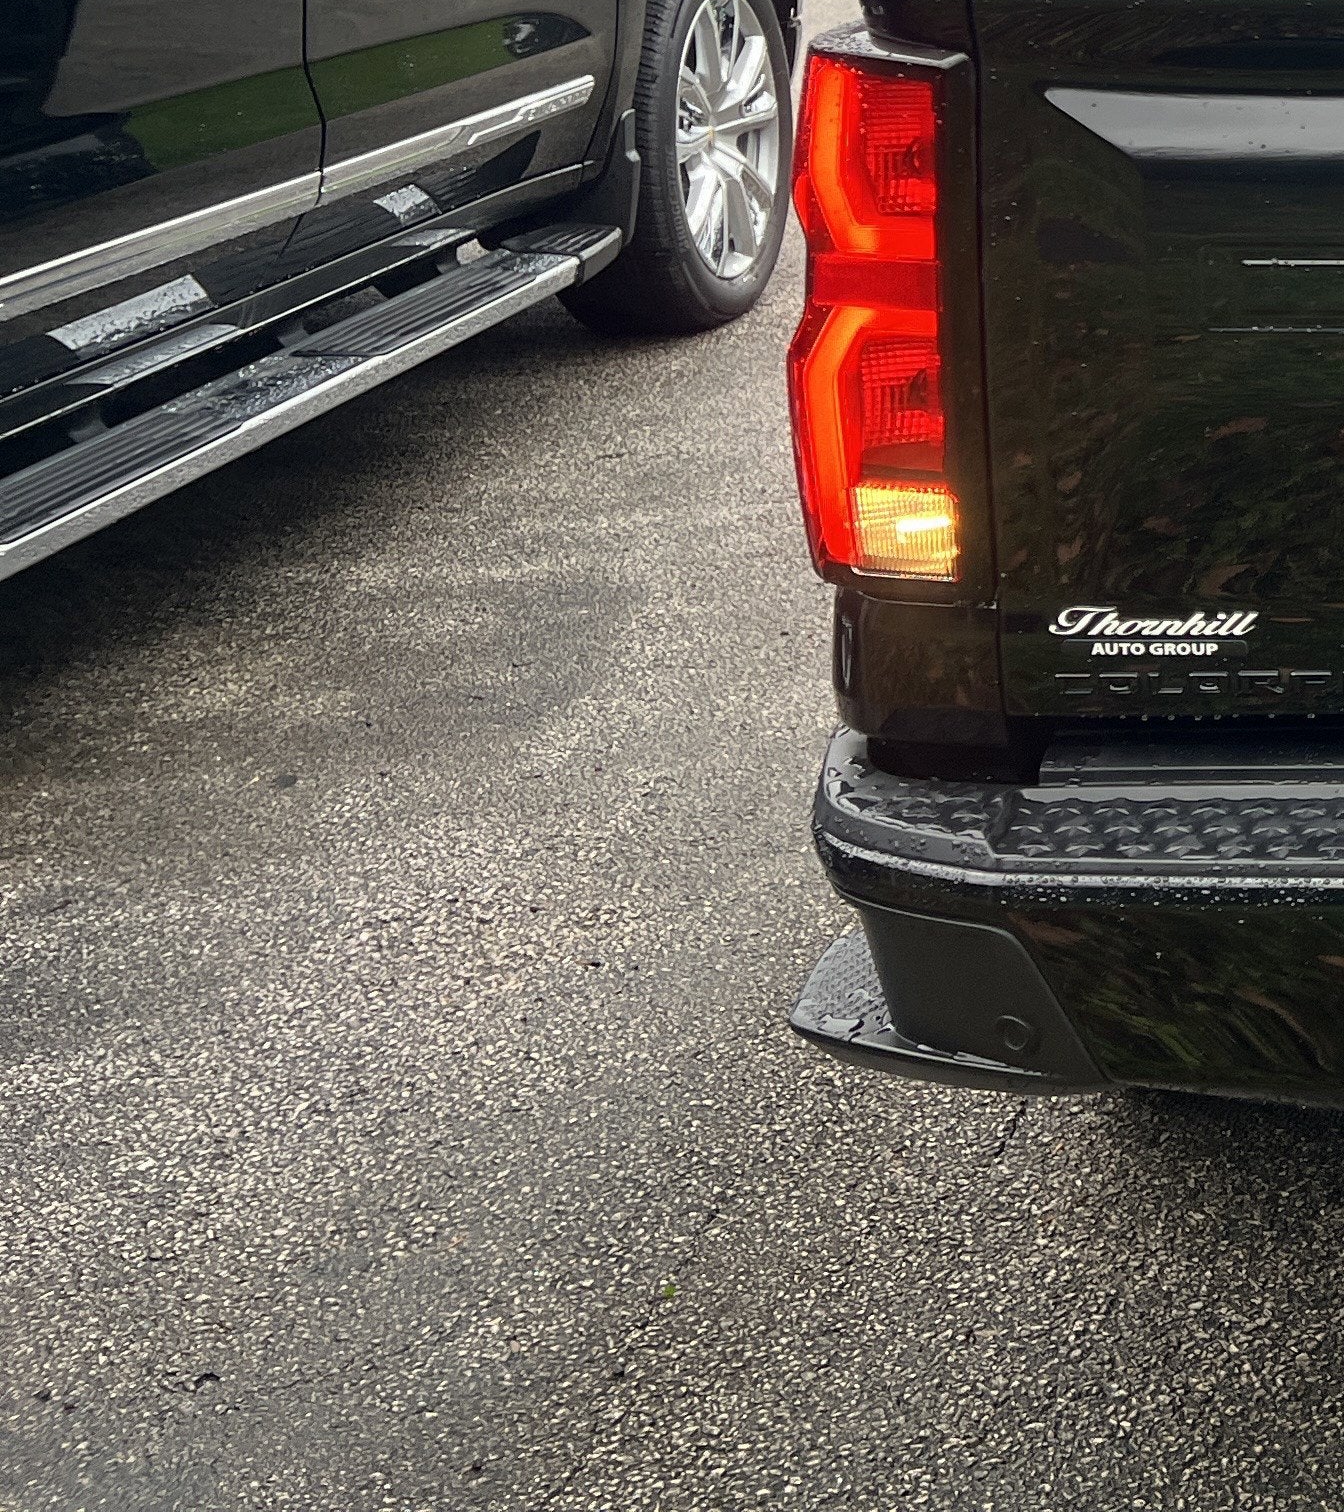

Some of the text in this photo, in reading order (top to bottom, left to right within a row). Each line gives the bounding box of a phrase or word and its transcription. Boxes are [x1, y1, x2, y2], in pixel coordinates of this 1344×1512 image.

[1049, 606, 1259, 636] Thornhill
[1091, 643, 1219, 656] AUTO GROUP
